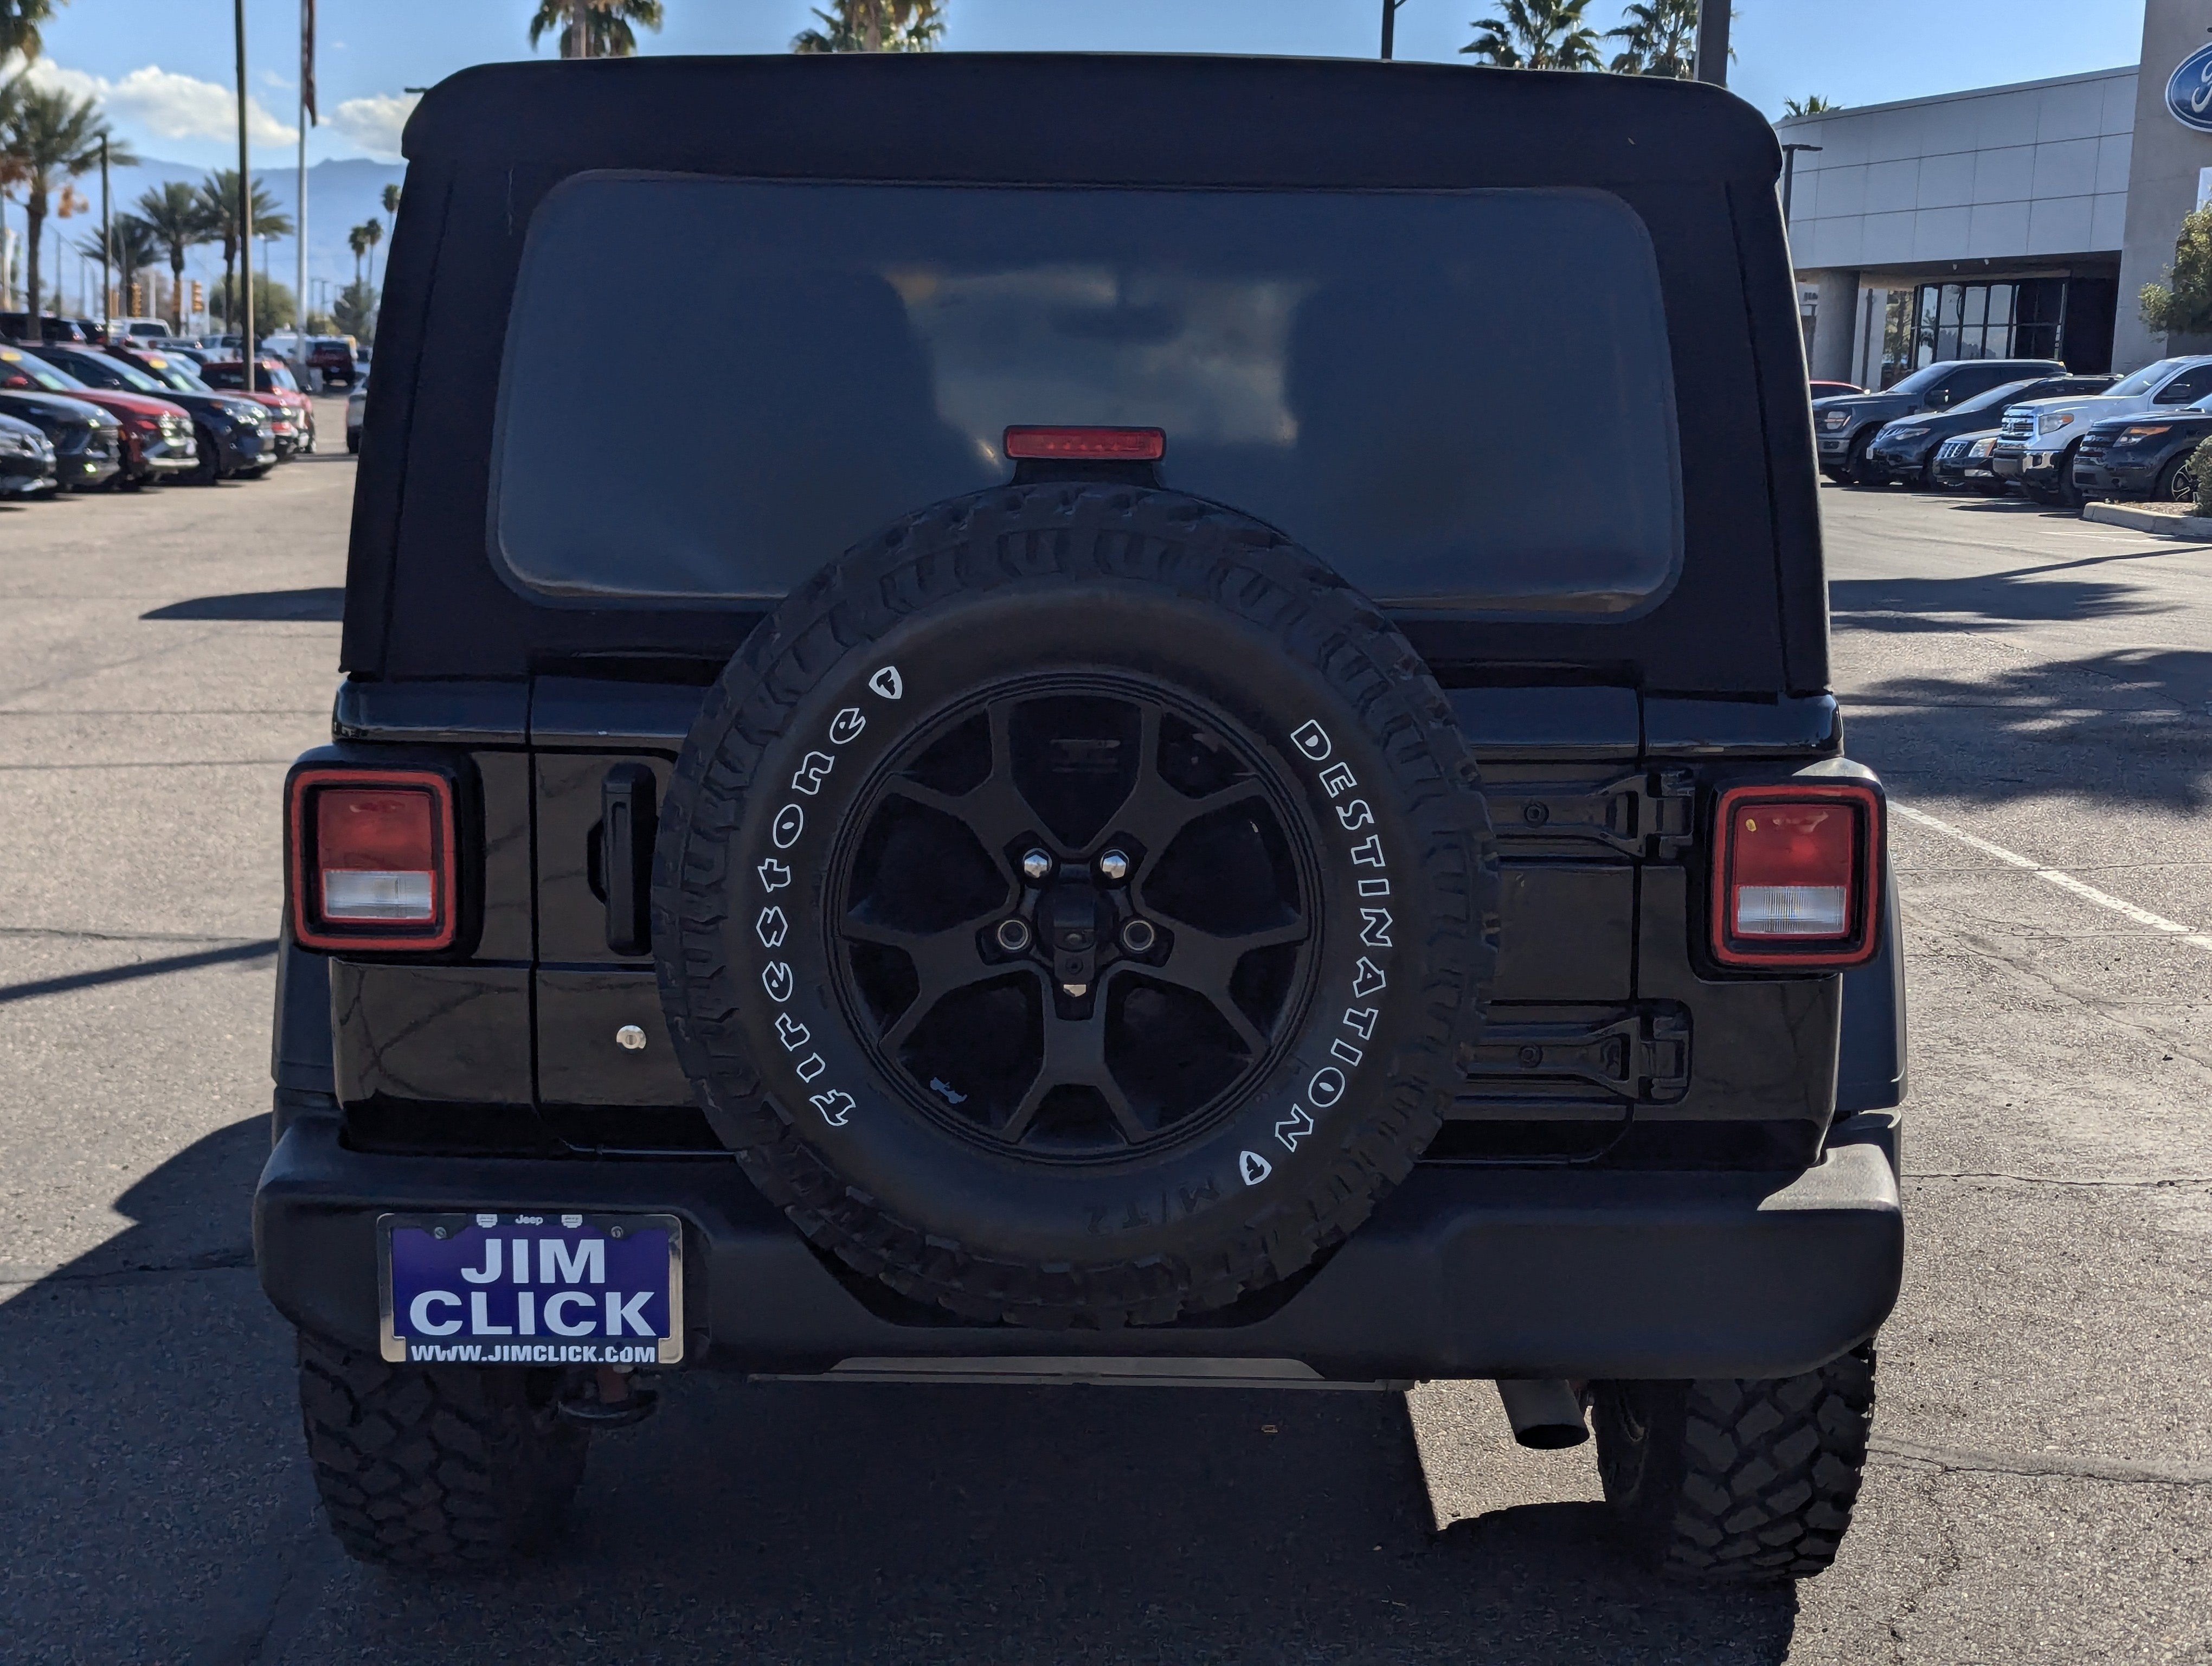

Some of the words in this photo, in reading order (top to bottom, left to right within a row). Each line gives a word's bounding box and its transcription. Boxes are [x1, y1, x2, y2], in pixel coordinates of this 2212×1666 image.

[1275, 719, 1393, 1152] DESTINATION
[515, 1214, 543, 1226] Jeep
[460, 1239, 606, 1284] JIM
[410, 1291, 657, 1336] CLICK
[410, 1345, 655, 1362] WWW.JIMCLICK.COM
